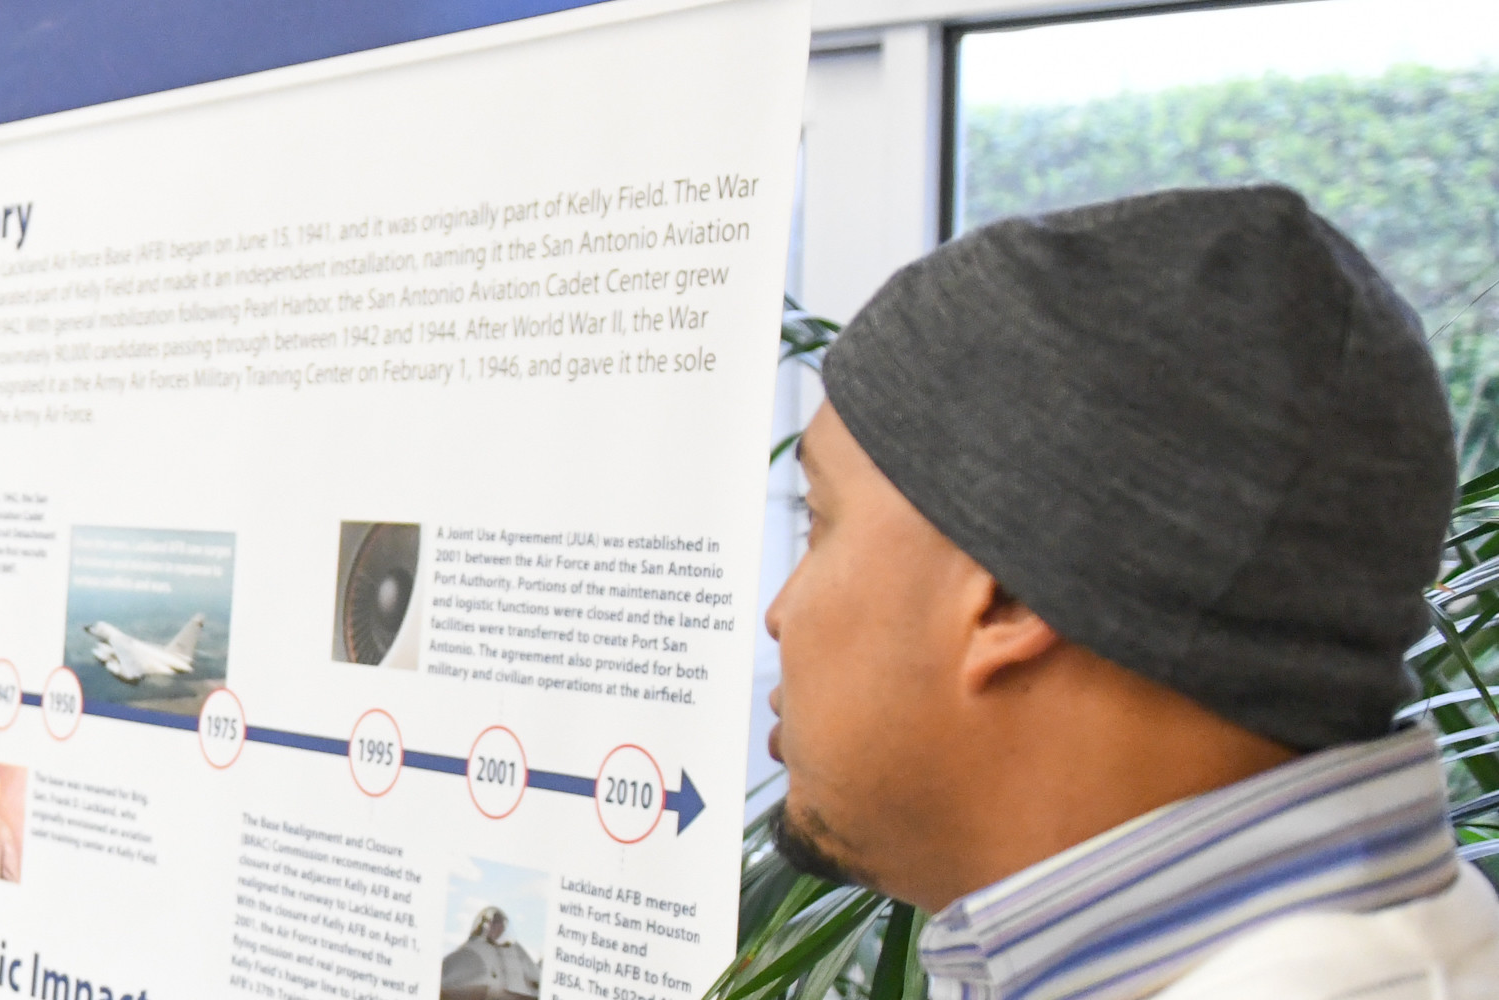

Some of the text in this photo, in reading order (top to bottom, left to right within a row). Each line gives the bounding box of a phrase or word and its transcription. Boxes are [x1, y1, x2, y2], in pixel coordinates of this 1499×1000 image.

[567, 176, 759, 217] Kelly Field. The War
[541, 220, 749, 258] San Antonio Aviation
[470, 267, 729, 300] Aviation Cadet Center grew
[466, 317, 508, 340] After
[512, 313, 563, 338] World
[569, 313, 606, 335] War
[633, 308, 663, 332] the
[669, 307, 708, 330] War
[528, 346, 716, 380] and gave it the sole
[499, 529, 563, 546] Agreement
[603, 536, 624, 548] was
[627, 534, 703, 551] established
[707, 537, 719, 552] in
[464, 549, 511, 566] between
[515, 552, 533, 567] the
[535, 554, 551, 568] Air
[555, 555, 589, 571] Force
[593, 557, 615, 572] and
[618, 558, 637, 573] the
[641, 560, 663, 575] San
[667, 561, 723, 579] Antonio
[433, 572, 733, 607] Port Authority. Portions of the maintenance depot
[432, 595, 735, 631] and logistic functions were closed and the land and
[430, 615, 687, 653] facilities were transferred to create Port San
[429, 639, 708, 681] Antonio. The agreement also provided for both
[427, 662, 696, 704] military and civilian operations at the airfield.
[49, 691, 75, 714] 1950
[206, 715, 237, 740] 1975
[358, 739, 393, 766] 1995
[476, 756, 516, 786] 2001
[605, 778, 652, 810] 2010
[560, 877, 697, 917] Lackland AFB merged
[559, 902, 700, 944] with Fort Sam Houston
[557, 924, 647, 956] Army Base and
[553, 973, 584, 993] JBSA.
[589, 981, 609, 998] The
[555, 948, 691, 993] Randolph AFB to form
